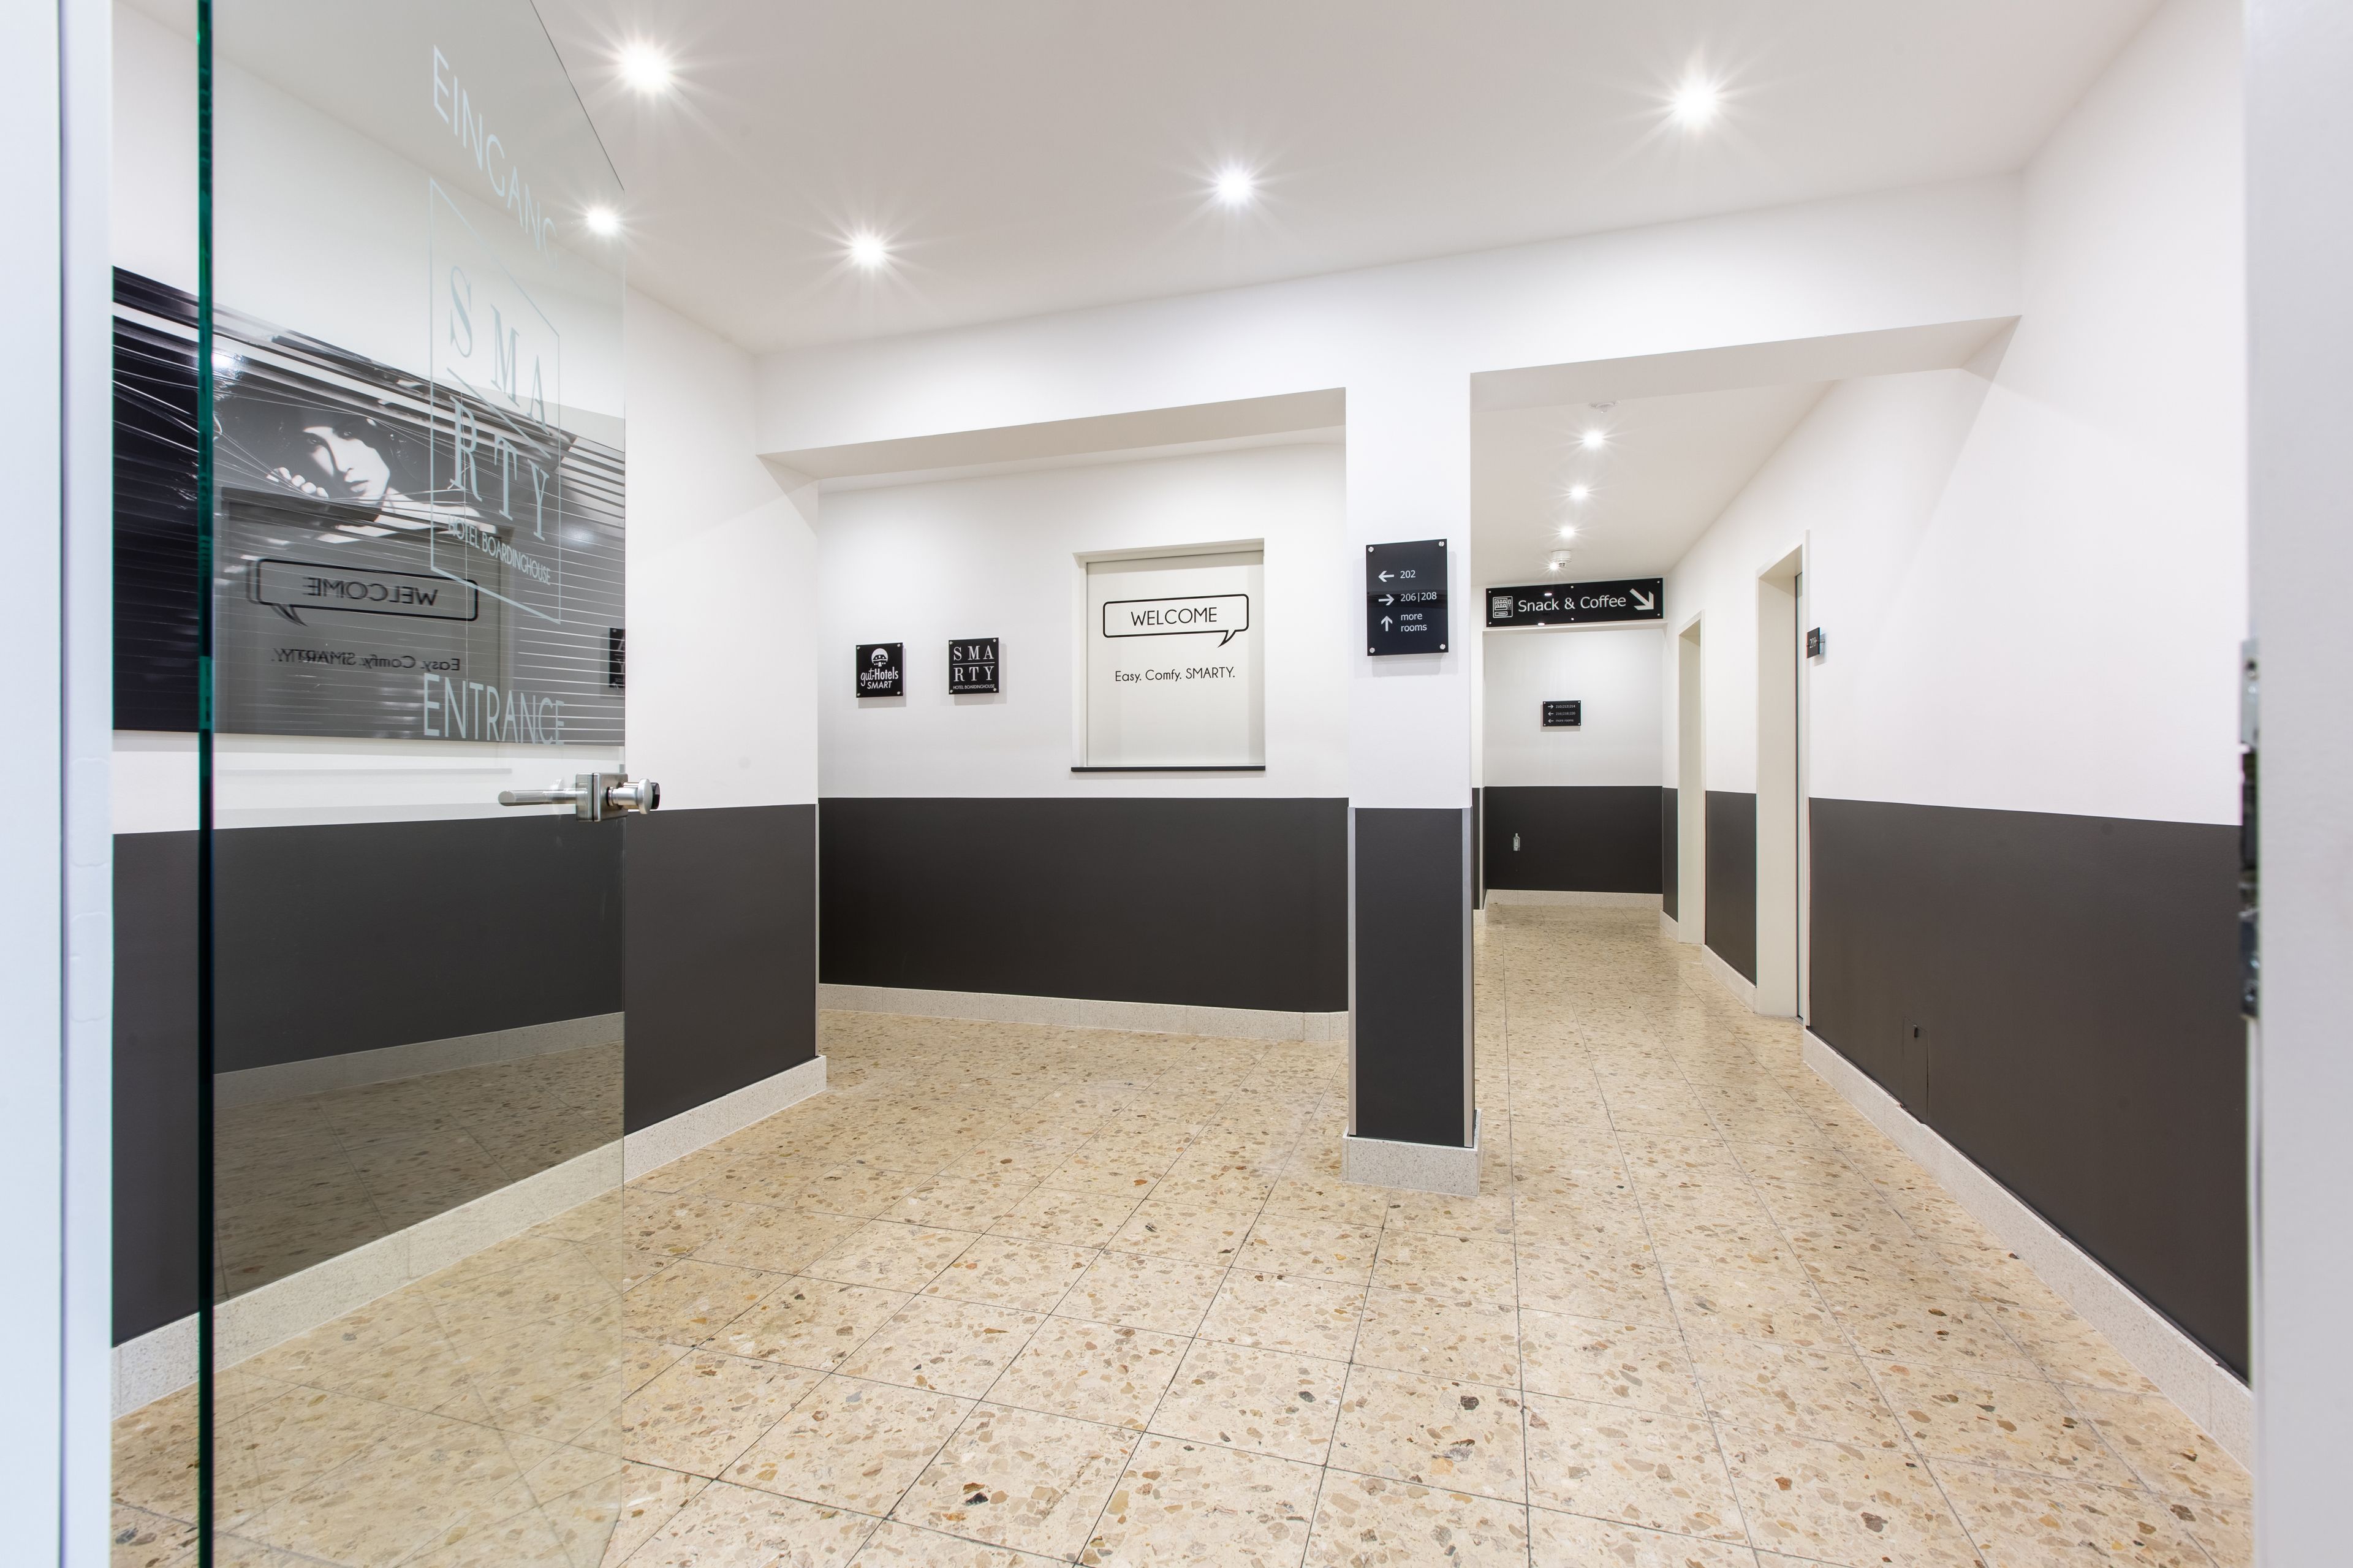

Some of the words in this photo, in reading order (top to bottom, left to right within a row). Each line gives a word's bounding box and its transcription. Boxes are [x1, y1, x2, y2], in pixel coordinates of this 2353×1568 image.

[448, 513, 480, 549] HOTEL
[482, 532, 551, 586] BOARDINGHOUSE
[1400, 570, 1415, 578] 202
[1518, 598, 1559, 612] Snack
[1564, 597, 1575, 609] &
[1580, 595, 1626, 608] Coffee
[1131, 607, 1217, 626] WELCOME
[860, 666, 898, 686] gut-Hotels
[1115, 670, 1142, 683] Easy.
[1145, 668, 1181, 681] Comfy.
[1186, 667, 1235, 679] SMARTY.
[867, 681, 892, 689] SMART
[424, 673, 564, 745] ENTRANCE
